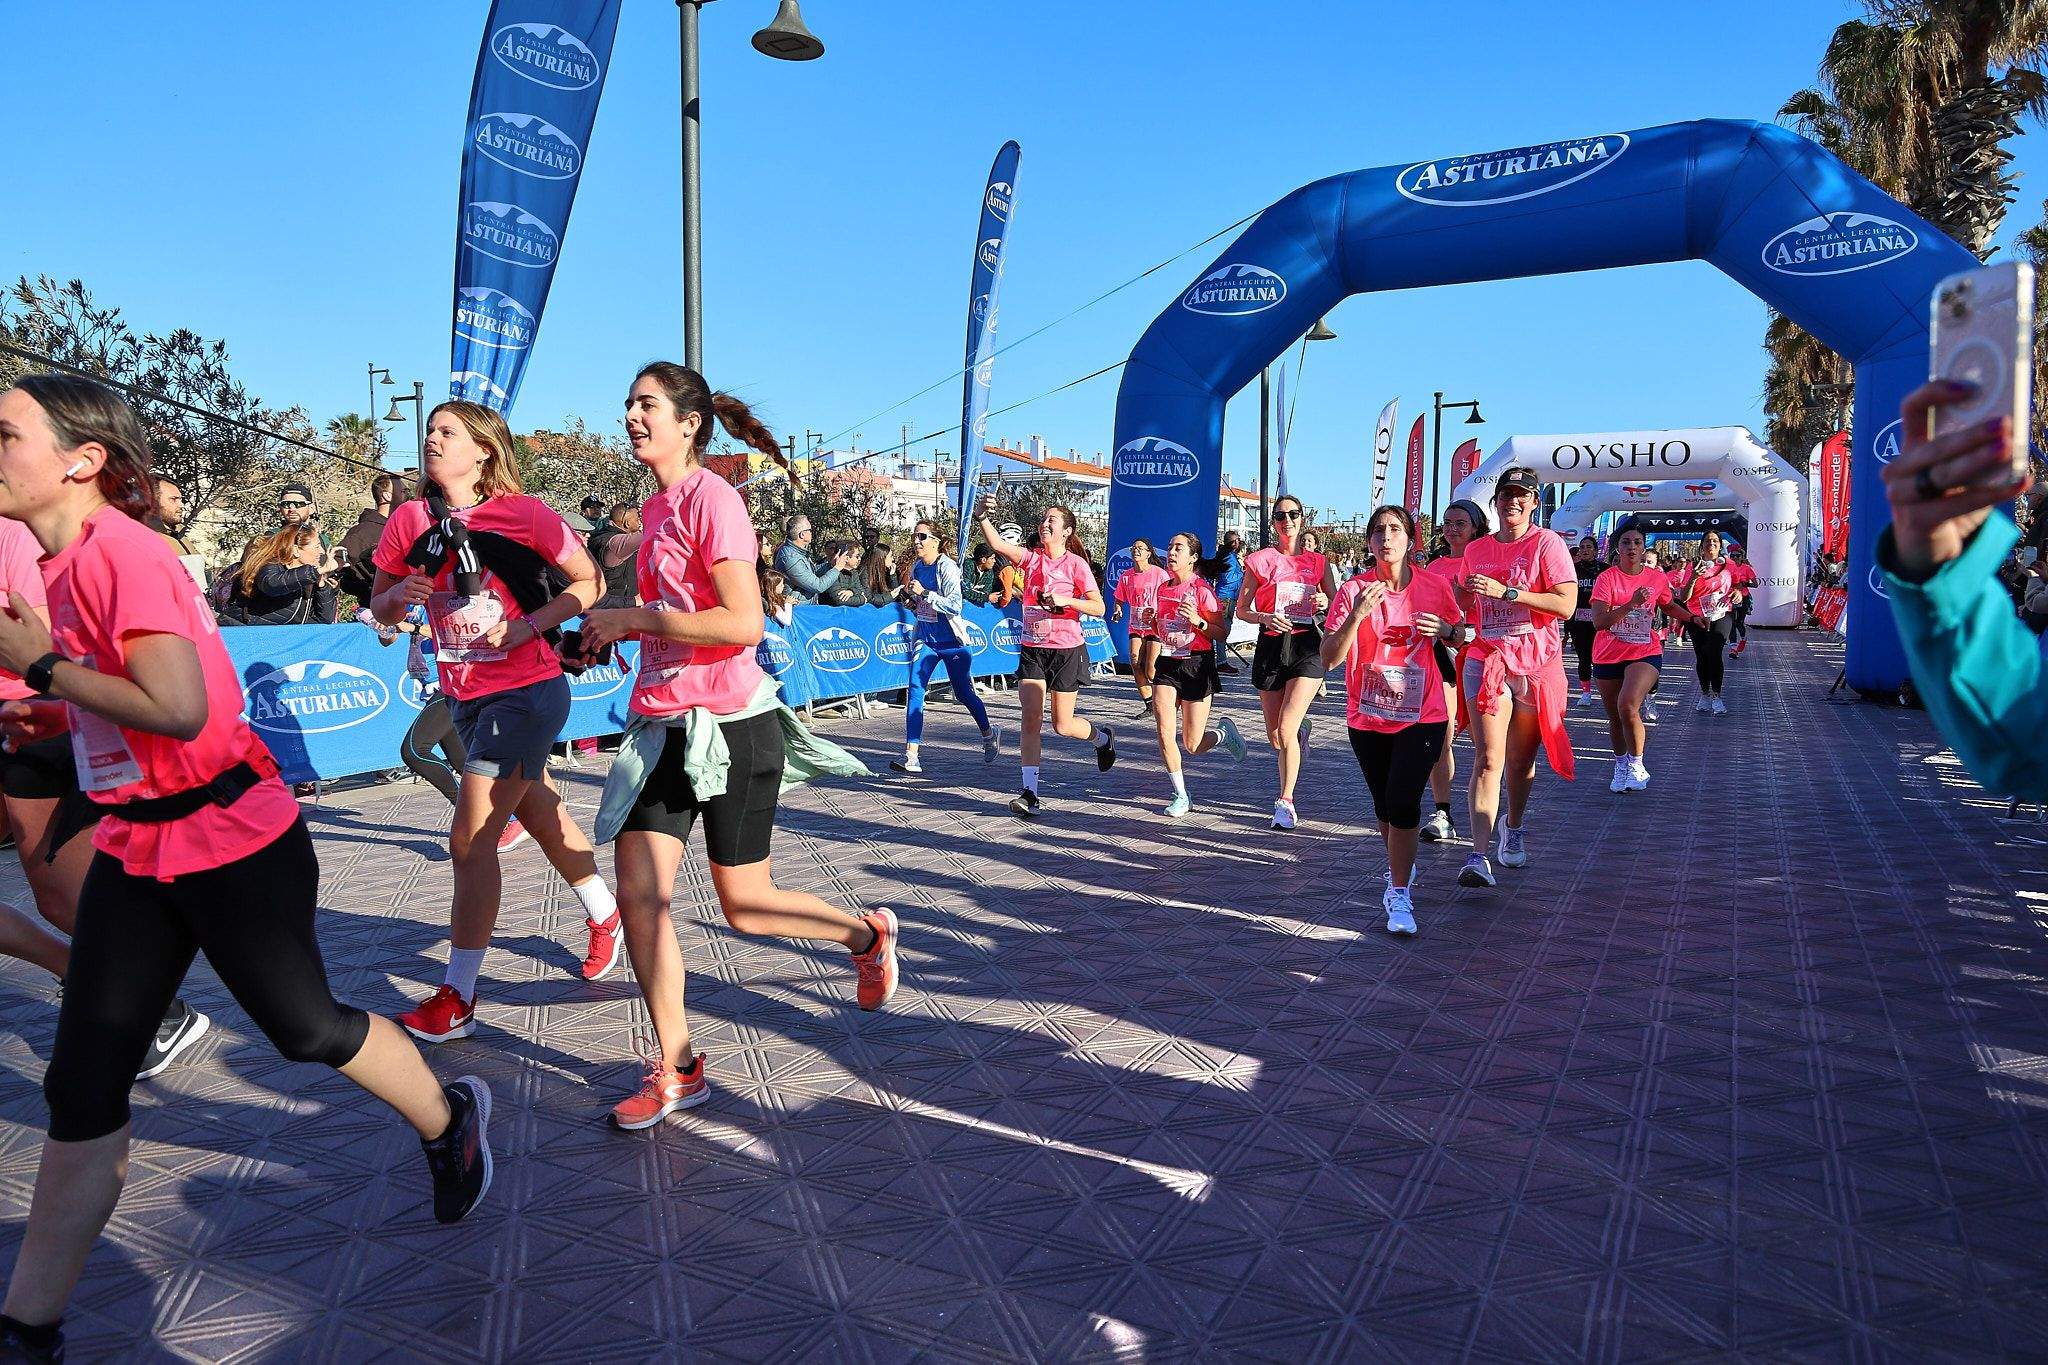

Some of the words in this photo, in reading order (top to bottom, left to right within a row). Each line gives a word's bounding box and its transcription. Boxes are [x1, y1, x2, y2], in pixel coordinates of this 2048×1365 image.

[497, 33, 590, 82] ASTURIANA
[476, 122, 573, 172] ASTURIANA
[1410, 142, 1610, 192] ASTURIANA
[1773, 235, 1909, 266] ASTURIANA
[1795, 231, 1847, 245] CENTRAL
[1187, 287, 1278, 305] ASTURIANA
[456, 308, 531, 343] STURIANA
[1115, 456, 1193, 477] ASTURIANA
[1551, 440, 1691, 470] OYSHO
[1411, 437, 1419, 505] Santander
[1732, 466, 1778, 476] OYSHO
[1831, 452, 1841, 514] Santander
[453, 622, 481, 635] 016
[648, 639, 669, 654] 016
[812, 645, 866, 663] ASTURIANA
[273, 684, 322, 695] CENTRAL
[325, 679, 372, 690] LECHERA
[1381, 688, 1404, 701] 016
[254, 688, 382, 720] ASTURIANA
